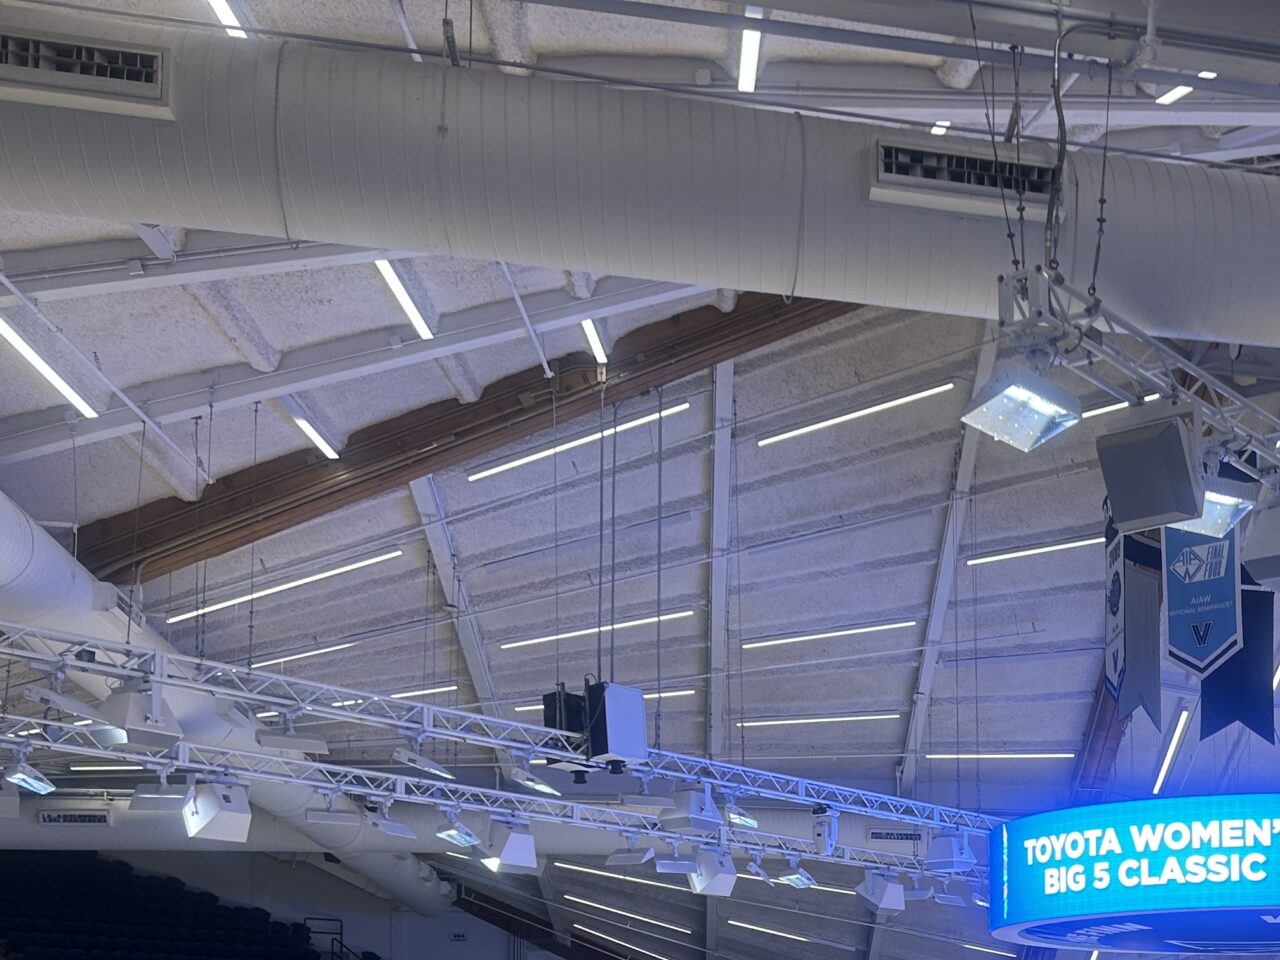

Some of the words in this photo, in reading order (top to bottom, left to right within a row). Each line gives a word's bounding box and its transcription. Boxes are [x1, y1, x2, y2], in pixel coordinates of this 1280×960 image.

[1024, 827, 1122, 866] TOYOTA
[1044, 863, 1086, 895] BIG
[1092, 862, 1110, 890] 5
[1118, 852, 1267, 888] CLASSIC
